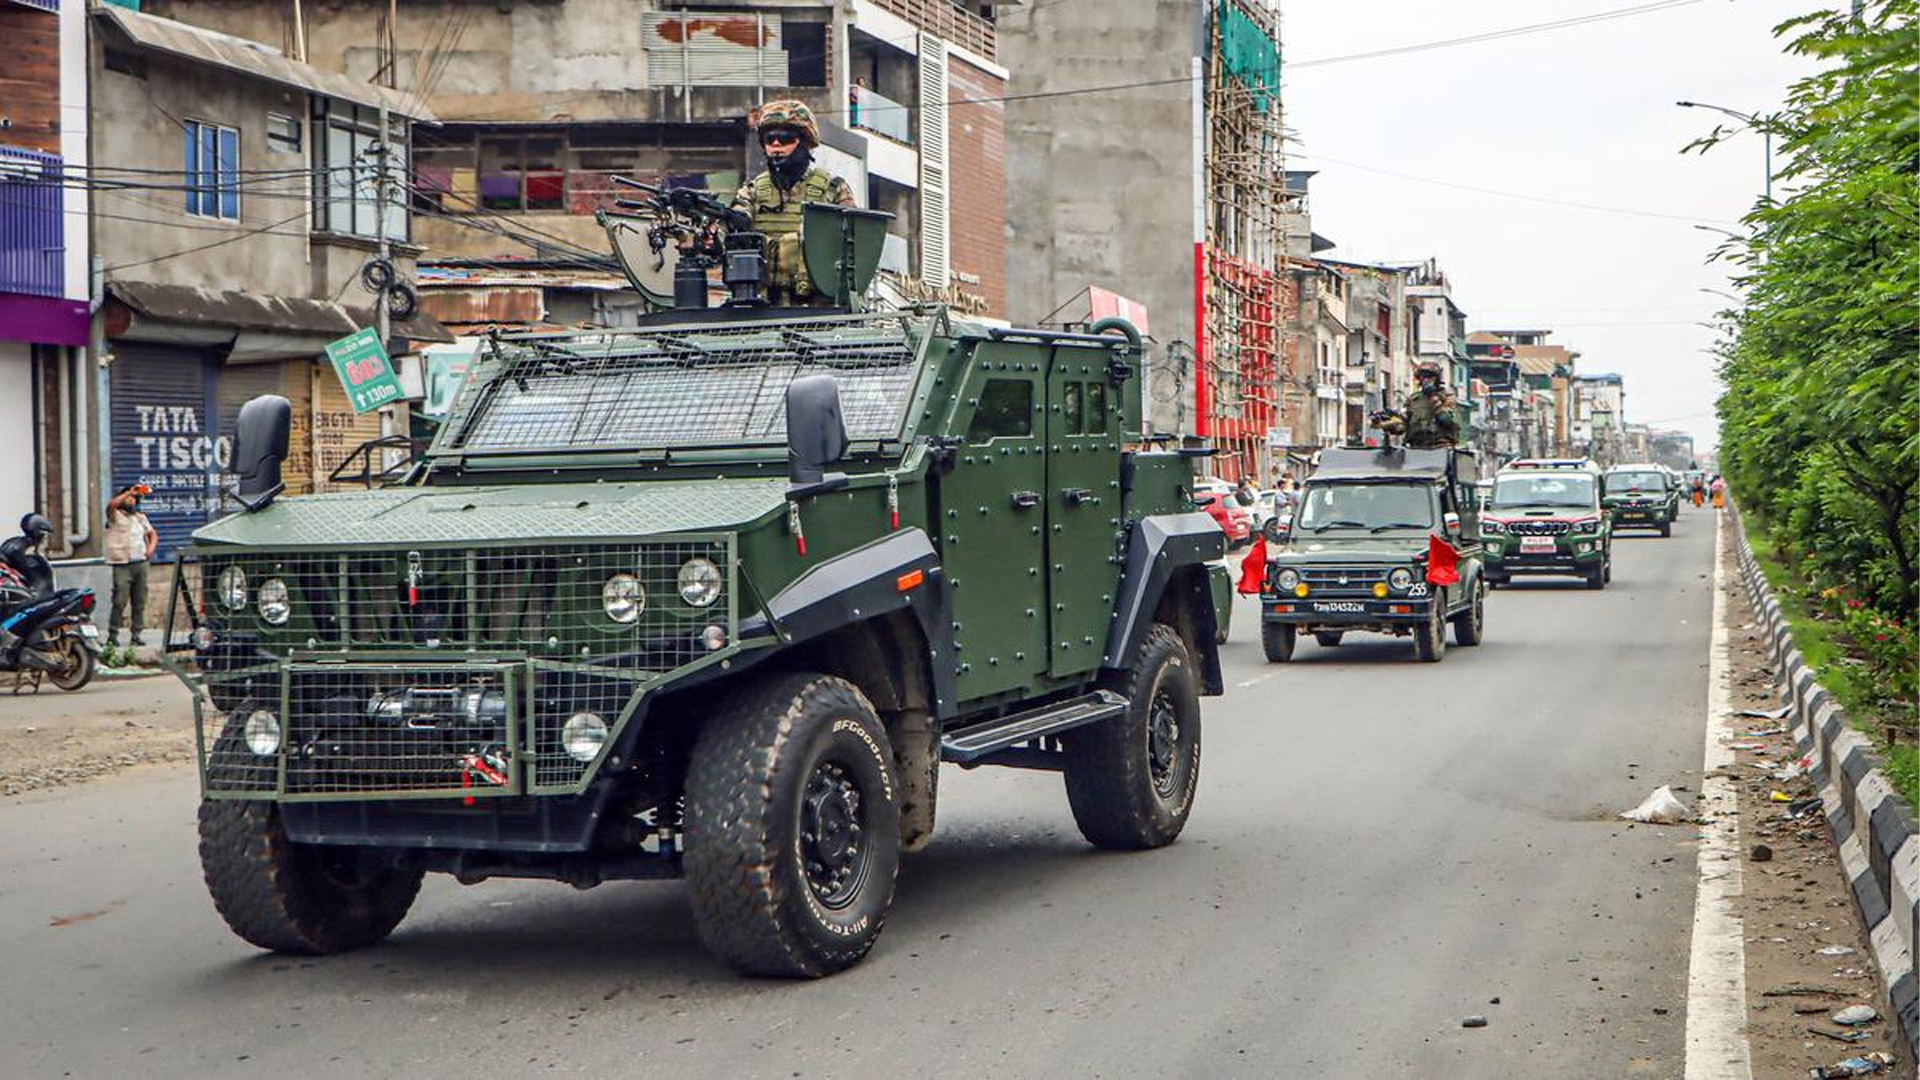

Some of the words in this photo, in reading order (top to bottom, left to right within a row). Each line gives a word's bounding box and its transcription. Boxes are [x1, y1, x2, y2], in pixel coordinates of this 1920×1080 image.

[366, 384, 397, 403] 130m
[135, 405, 199, 432] TATA
[135, 435, 236, 470] TISCO
[1407, 582, 1427, 597] 255
[832, 719, 892, 801] BFGoodrich
